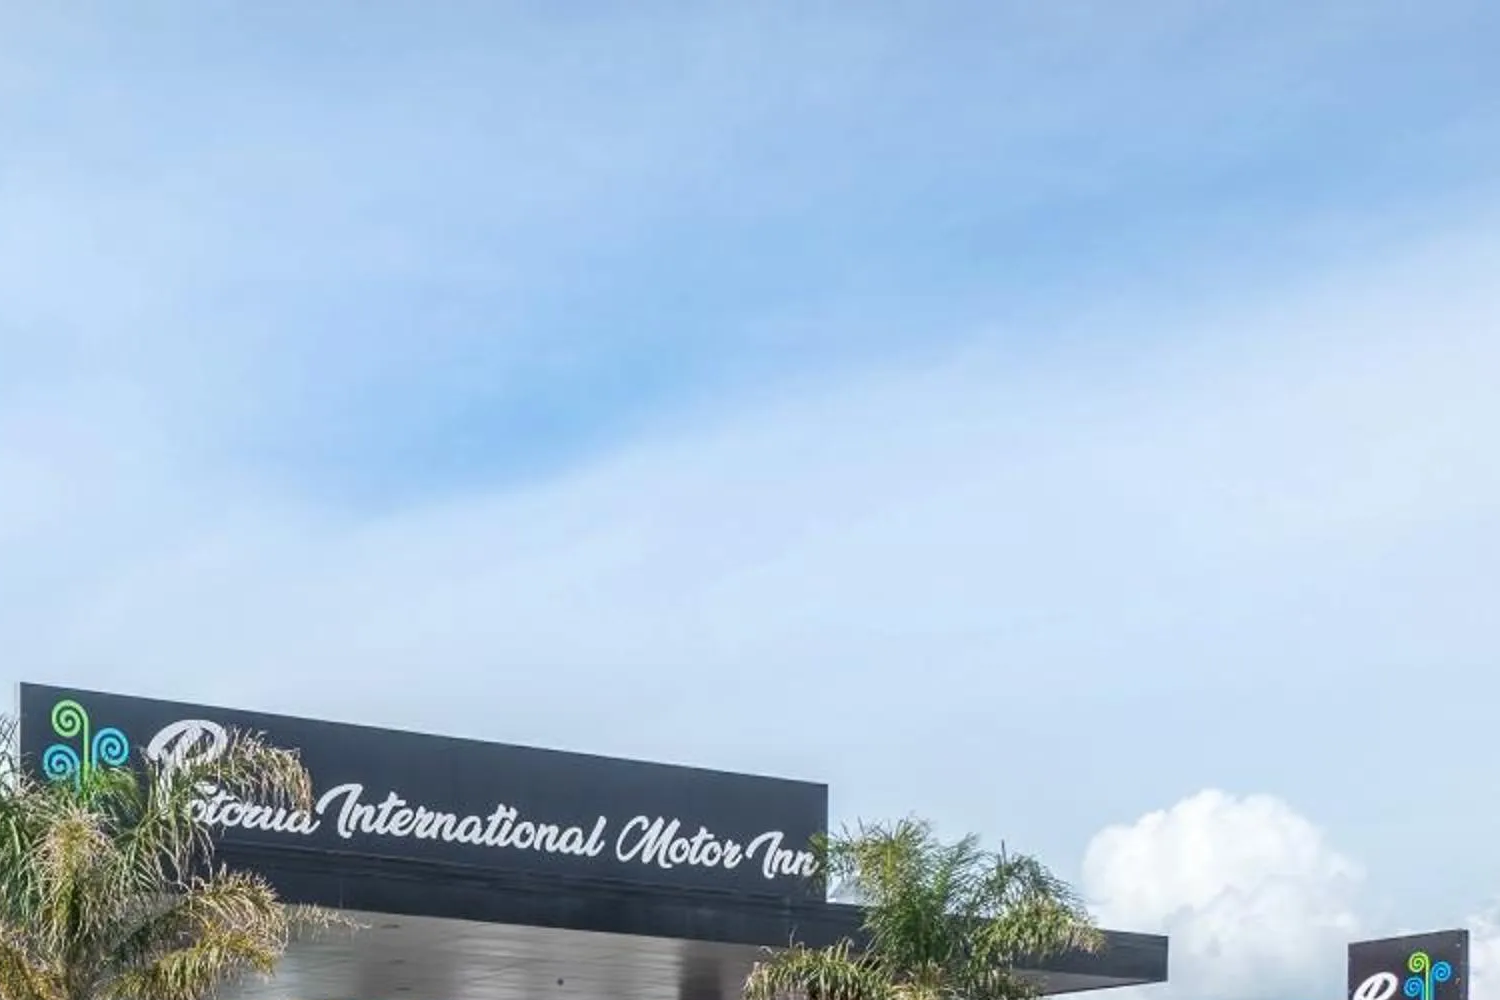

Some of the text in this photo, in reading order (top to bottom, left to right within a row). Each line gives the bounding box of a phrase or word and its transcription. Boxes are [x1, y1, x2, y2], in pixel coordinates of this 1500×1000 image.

[147, 719, 820, 879] Rotorua International Motor Inn
